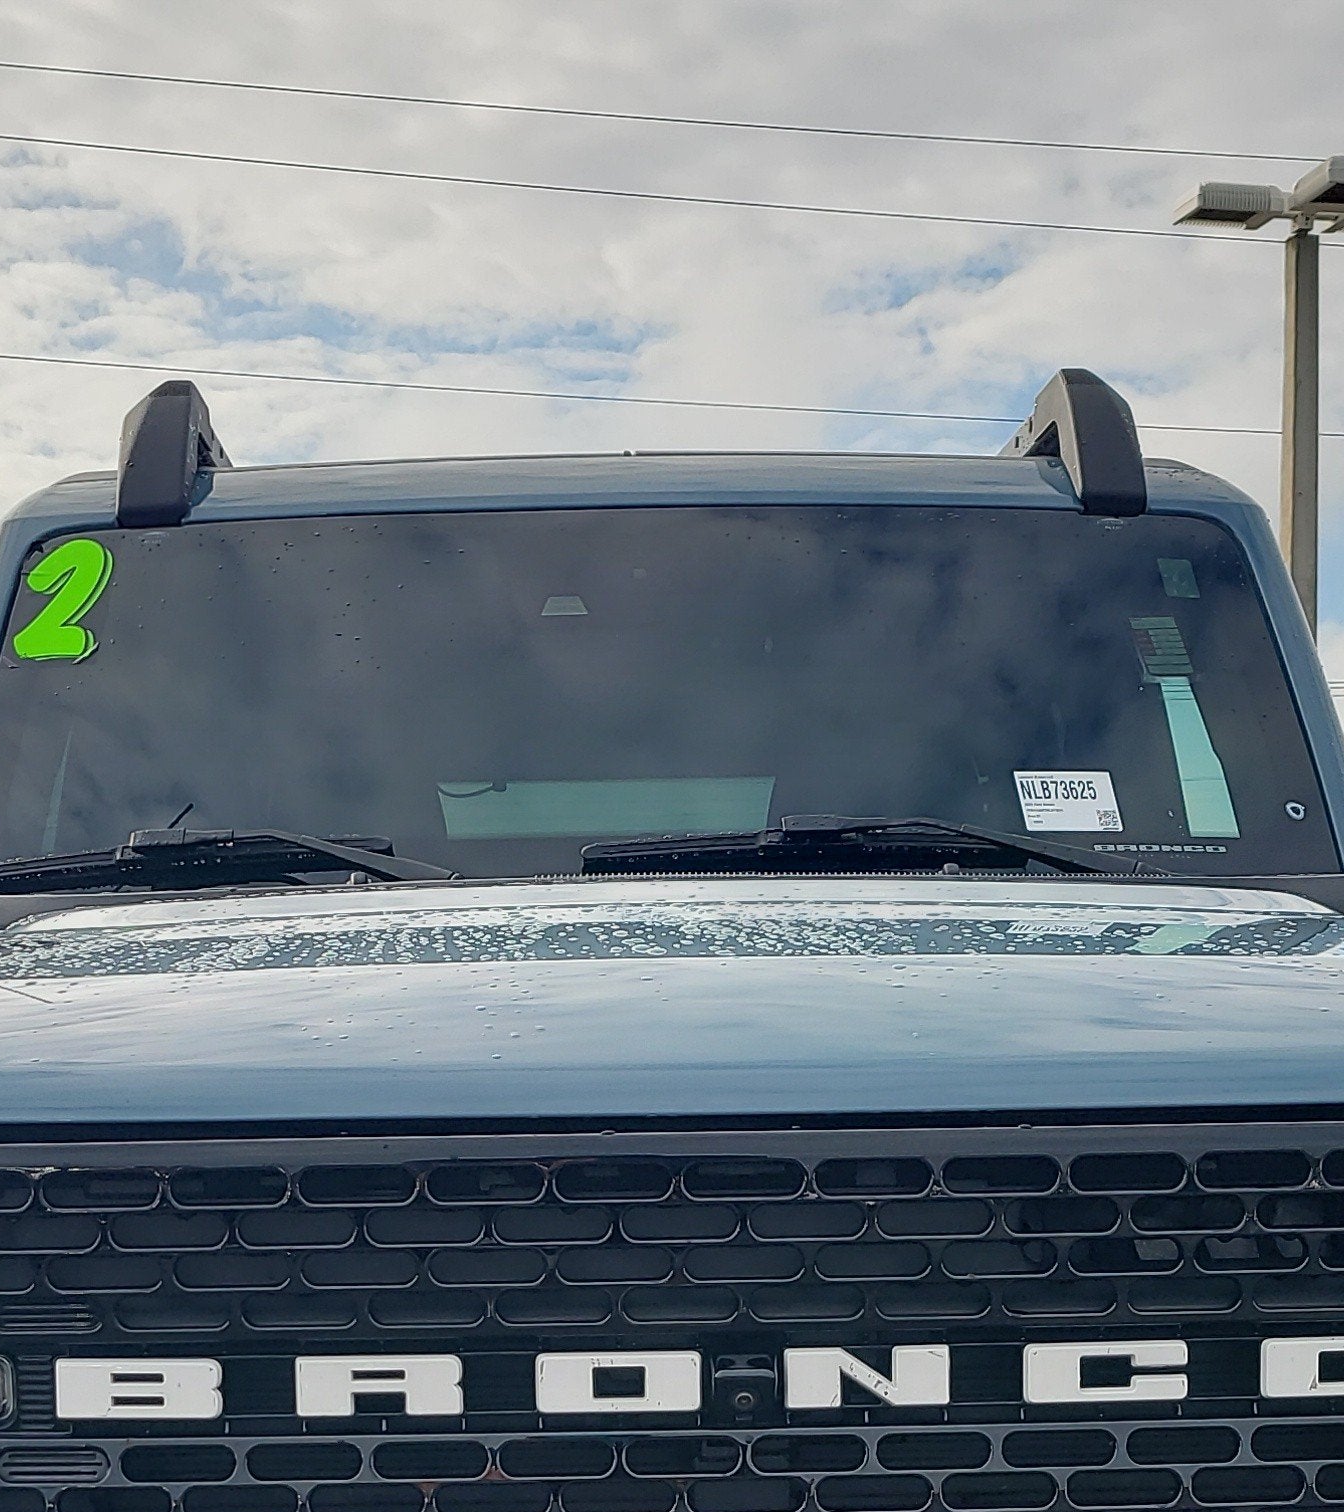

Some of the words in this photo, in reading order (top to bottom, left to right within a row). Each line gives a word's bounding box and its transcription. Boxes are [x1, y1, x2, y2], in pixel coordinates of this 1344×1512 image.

[11, 538, 115, 664] 2
[1019, 780, 1097, 800] NLB73625
[1093, 844, 1227, 853] BRONCO
